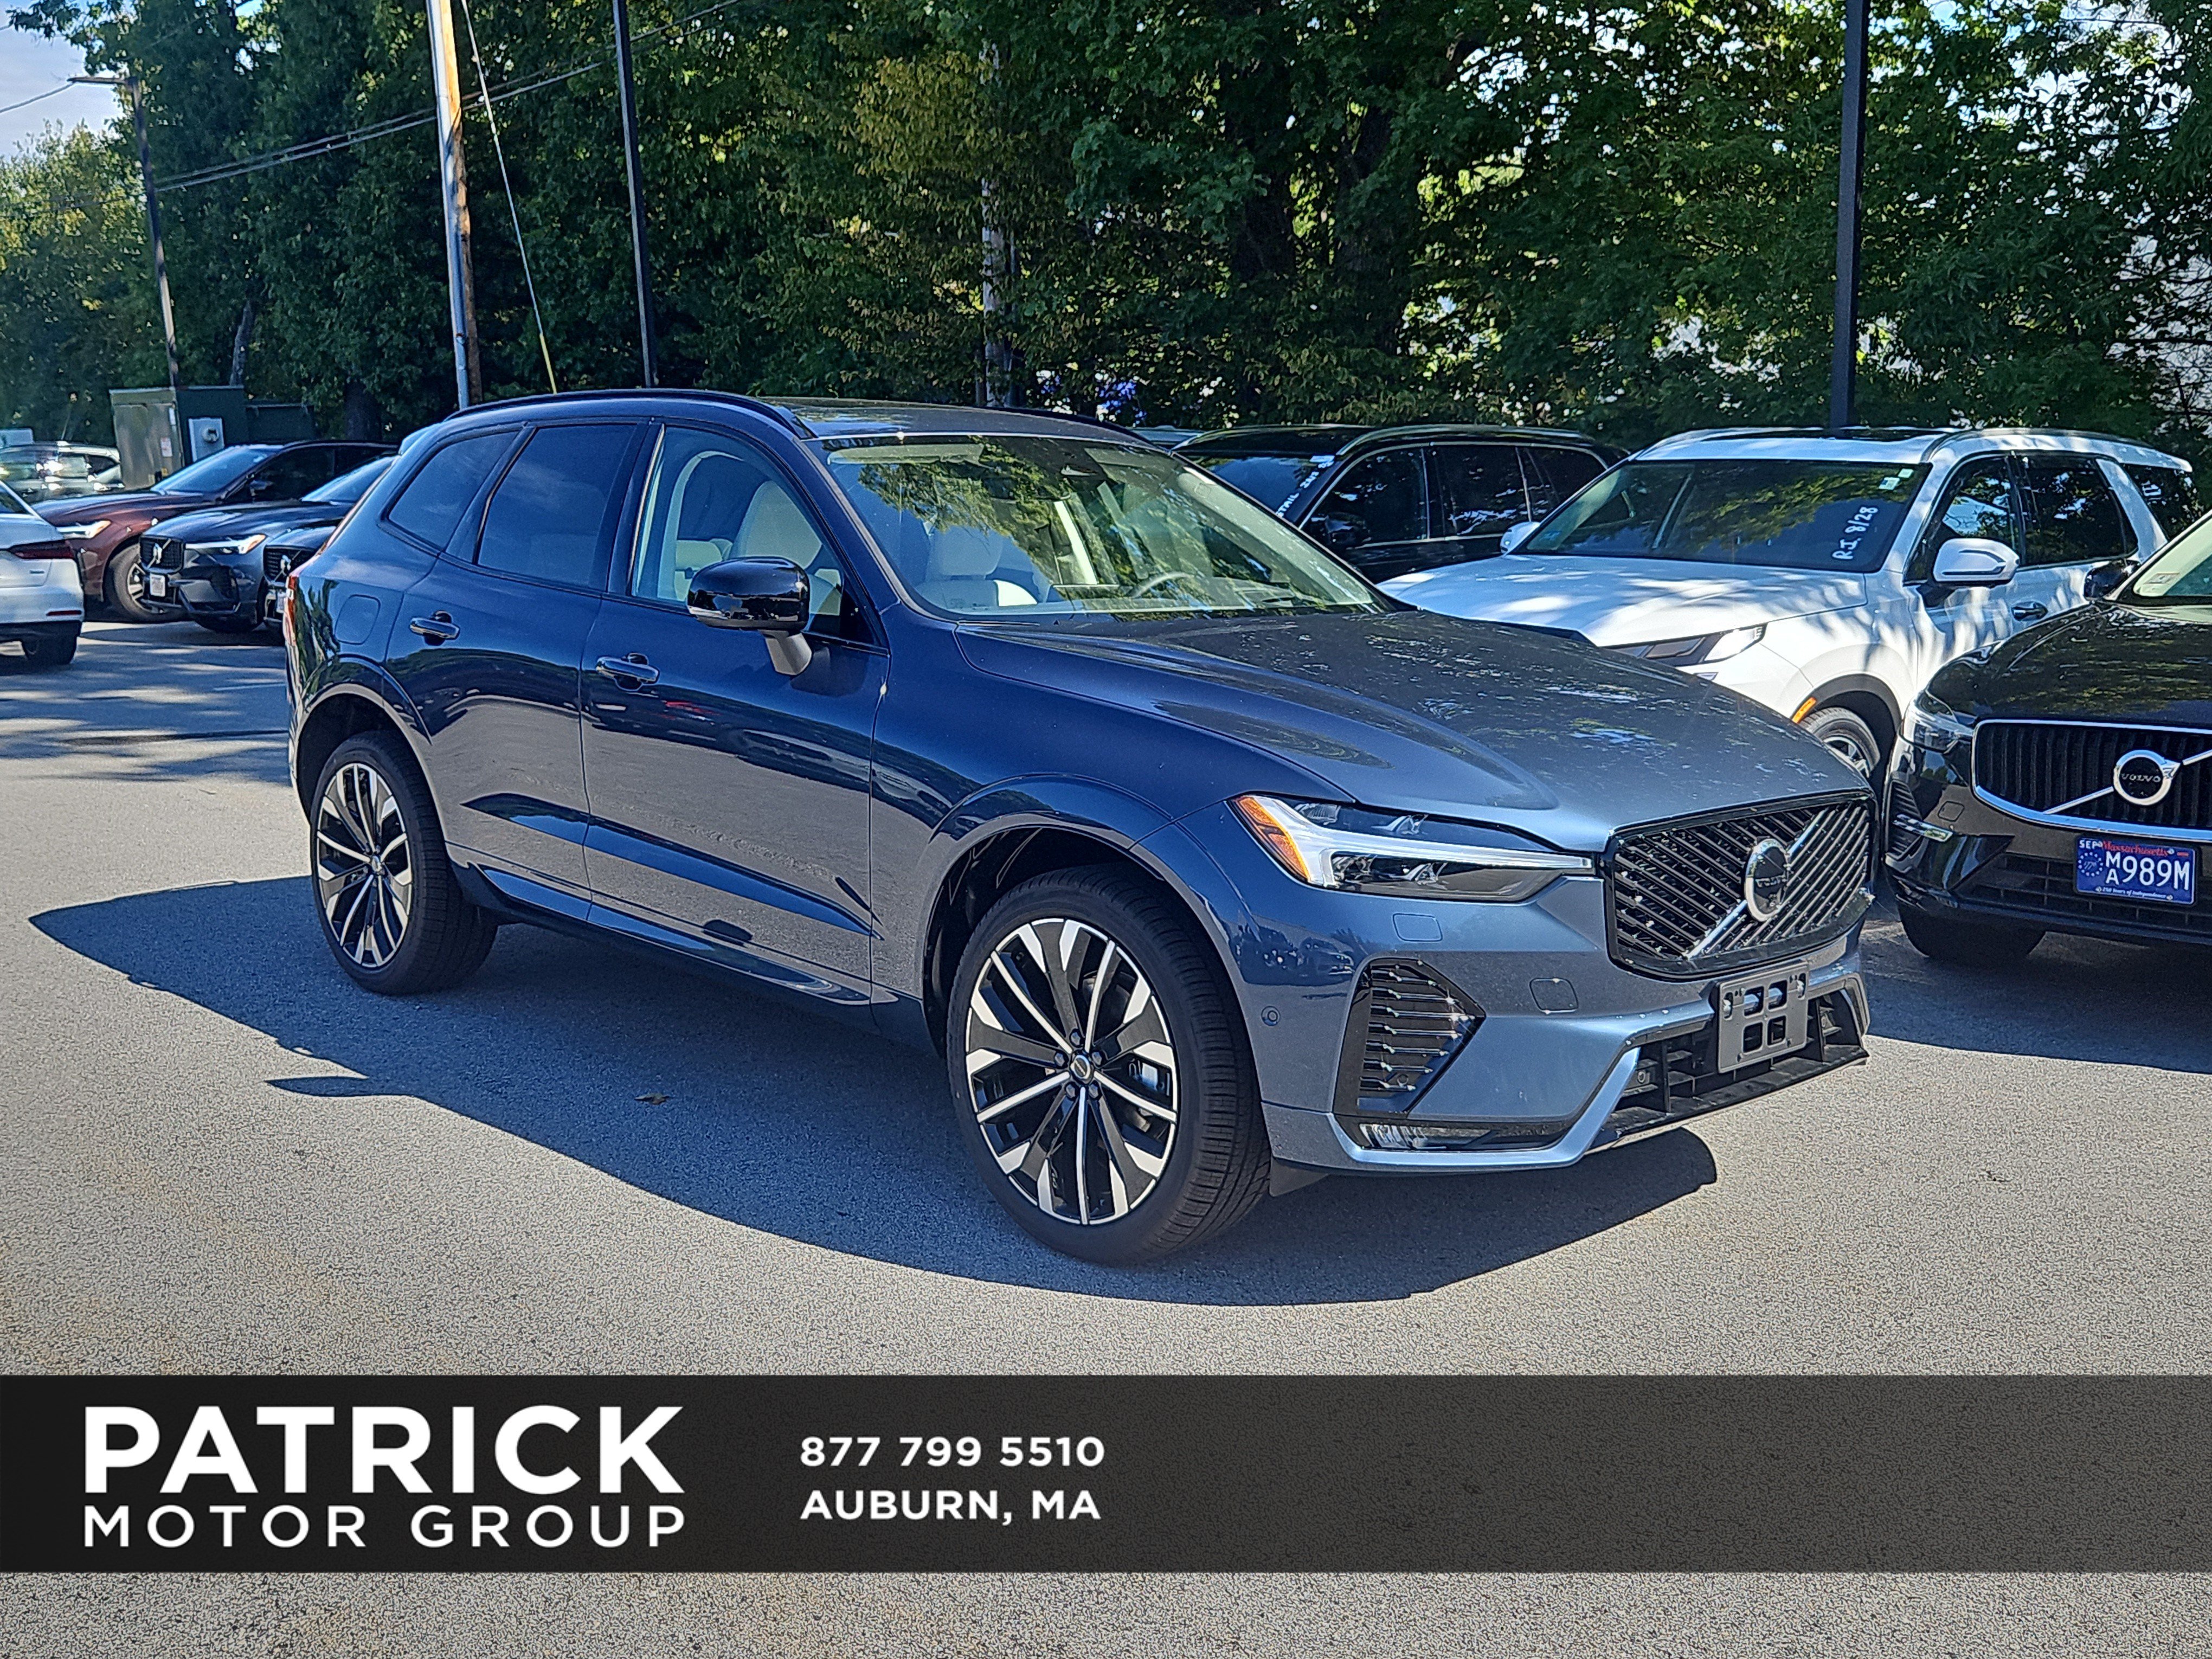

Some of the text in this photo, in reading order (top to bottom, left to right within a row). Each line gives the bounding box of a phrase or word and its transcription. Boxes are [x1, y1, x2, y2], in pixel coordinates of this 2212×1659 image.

[1844, 506, 1878, 533] 8/28
[2121, 773, 2161, 783] VOLVO
[2101, 840, 2168, 857] Massachusetts
